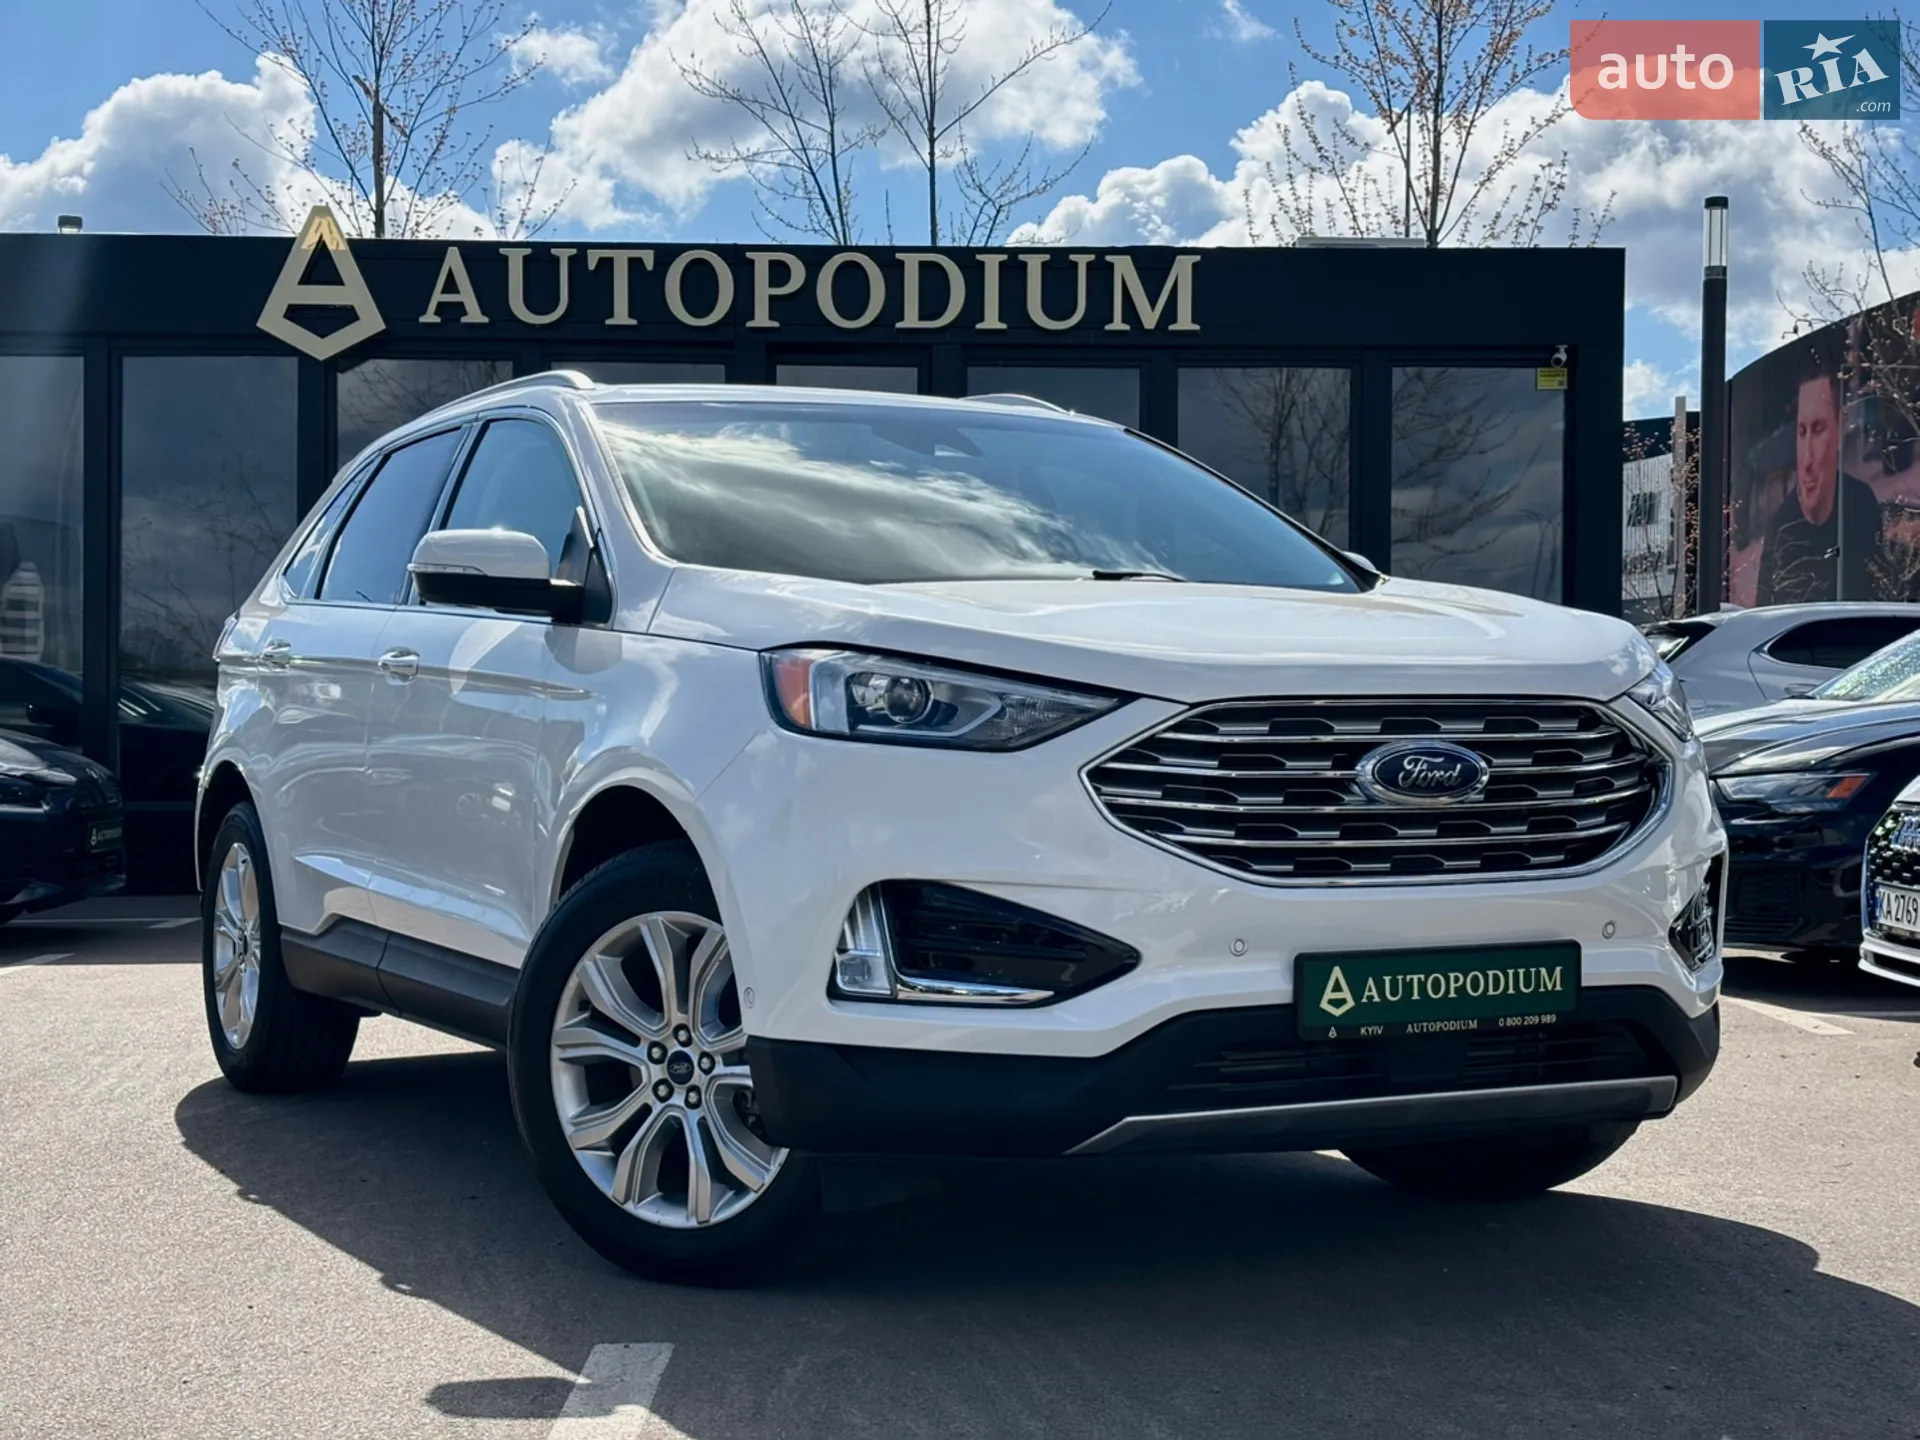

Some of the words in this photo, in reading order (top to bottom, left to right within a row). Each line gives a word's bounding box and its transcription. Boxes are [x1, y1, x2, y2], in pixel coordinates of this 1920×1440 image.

[419, 245, 1201, 333] AUTOPODIUM
[1398, 755, 1462, 788] Ford
[1879, 890, 1892, 920] KA
[1894, 894, 1919, 925] 2769
[1361, 966, 1563, 1003] AUTOPODIUM
[1360, 1025, 1384, 1036] KYIV
[1406, 1019, 1478, 1034] AUTOPODIUM
[1499, 1018, 1505, 1027] 0
[1506, 1016, 1522, 1027] 800
[1523, 1015, 1540, 1026] 209
[1540, 1013, 1557, 1024] 989
